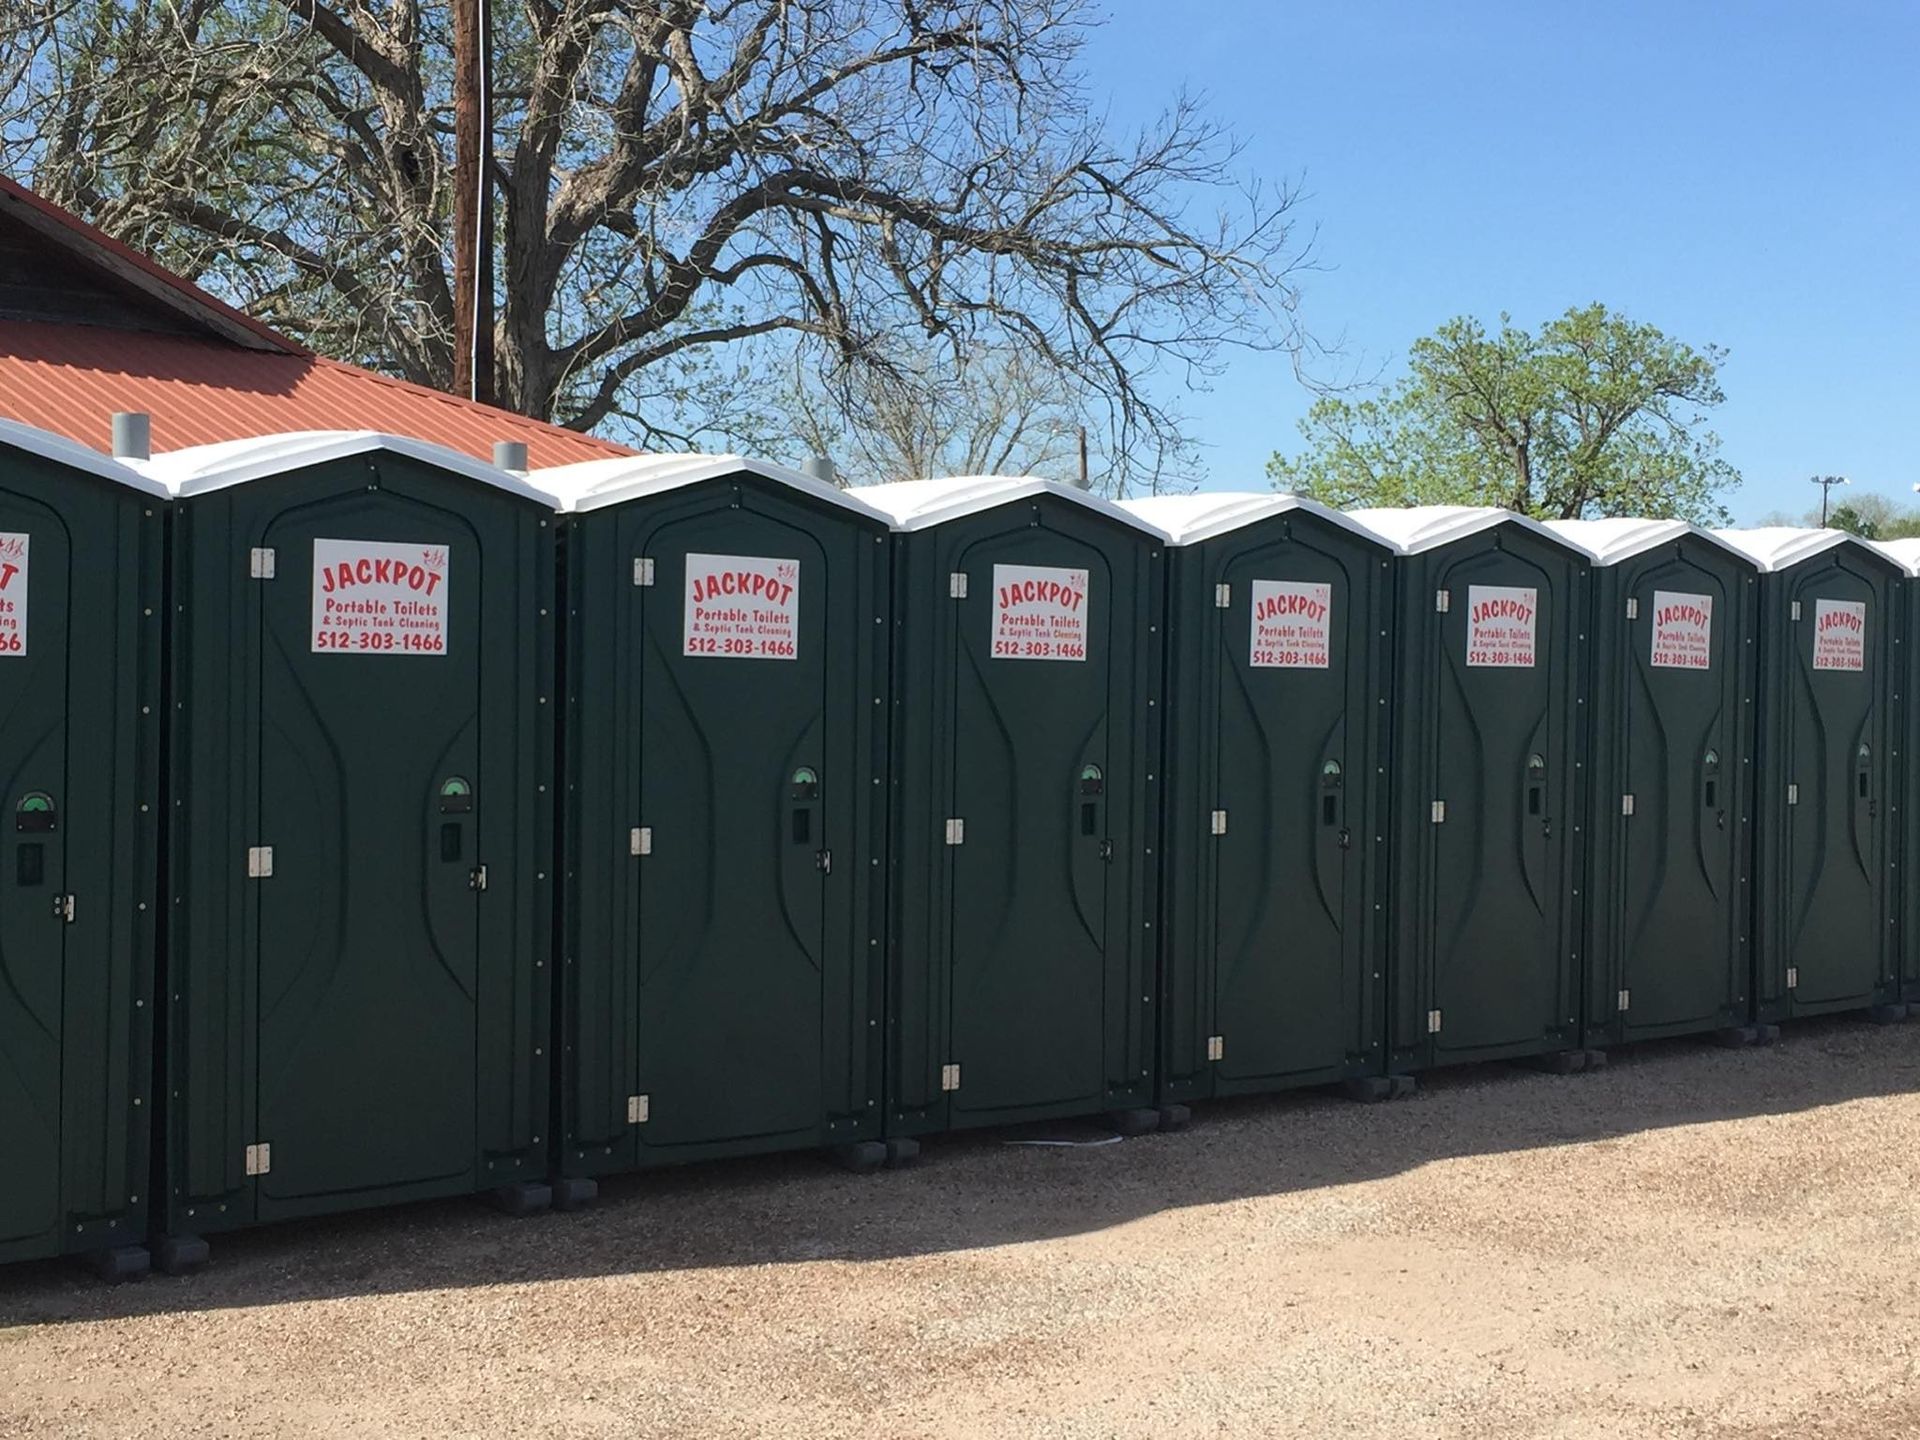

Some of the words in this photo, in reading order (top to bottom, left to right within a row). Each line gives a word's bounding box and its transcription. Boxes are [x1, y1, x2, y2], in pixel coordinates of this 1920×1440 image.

[323, 558, 442, 596] JACKPOT
[693, 572, 793, 606] JACKPOT
[999, 581, 1083, 612] JACKPOT
[326, 598, 387, 614] Portable
[394, 601, 438, 616] Toilets
[1257, 595, 1326, 622] JACKPOT
[1473, 600, 1532, 625] JACKPOT
[323, 615, 331, 625] &
[336, 616, 368, 628] Septic
[373, 617, 394, 626] Tank
[399, 618, 439, 631] Cleaning
[696, 608, 747, 622] Portable
[753, 610, 790, 624] Toilets
[1002, 613, 1045, 626] Portable
[1050, 615, 1080, 628] Toilets
[1657, 605, 1708, 630] JACKPOT
[1819, 612, 1862, 633] JACKPOT
[693, 623, 700, 631] &
[704, 623, 731, 634] Septic
[736, 625, 753, 633] Tank
[758, 625, 791, 638] Cleaning
[1259, 626, 1295, 637] Portable
[318, 631, 443, 650] 512-303-1466
[689, 638, 794, 655] 512-303-1466
[995, 641, 1083, 657] 512-303-1466
[1254, 651, 1326, 665] 512-303-1466
[1470, 651, 1532, 664] 512-303-1466
[1653, 652, 1707, 666] 512-303-1466
